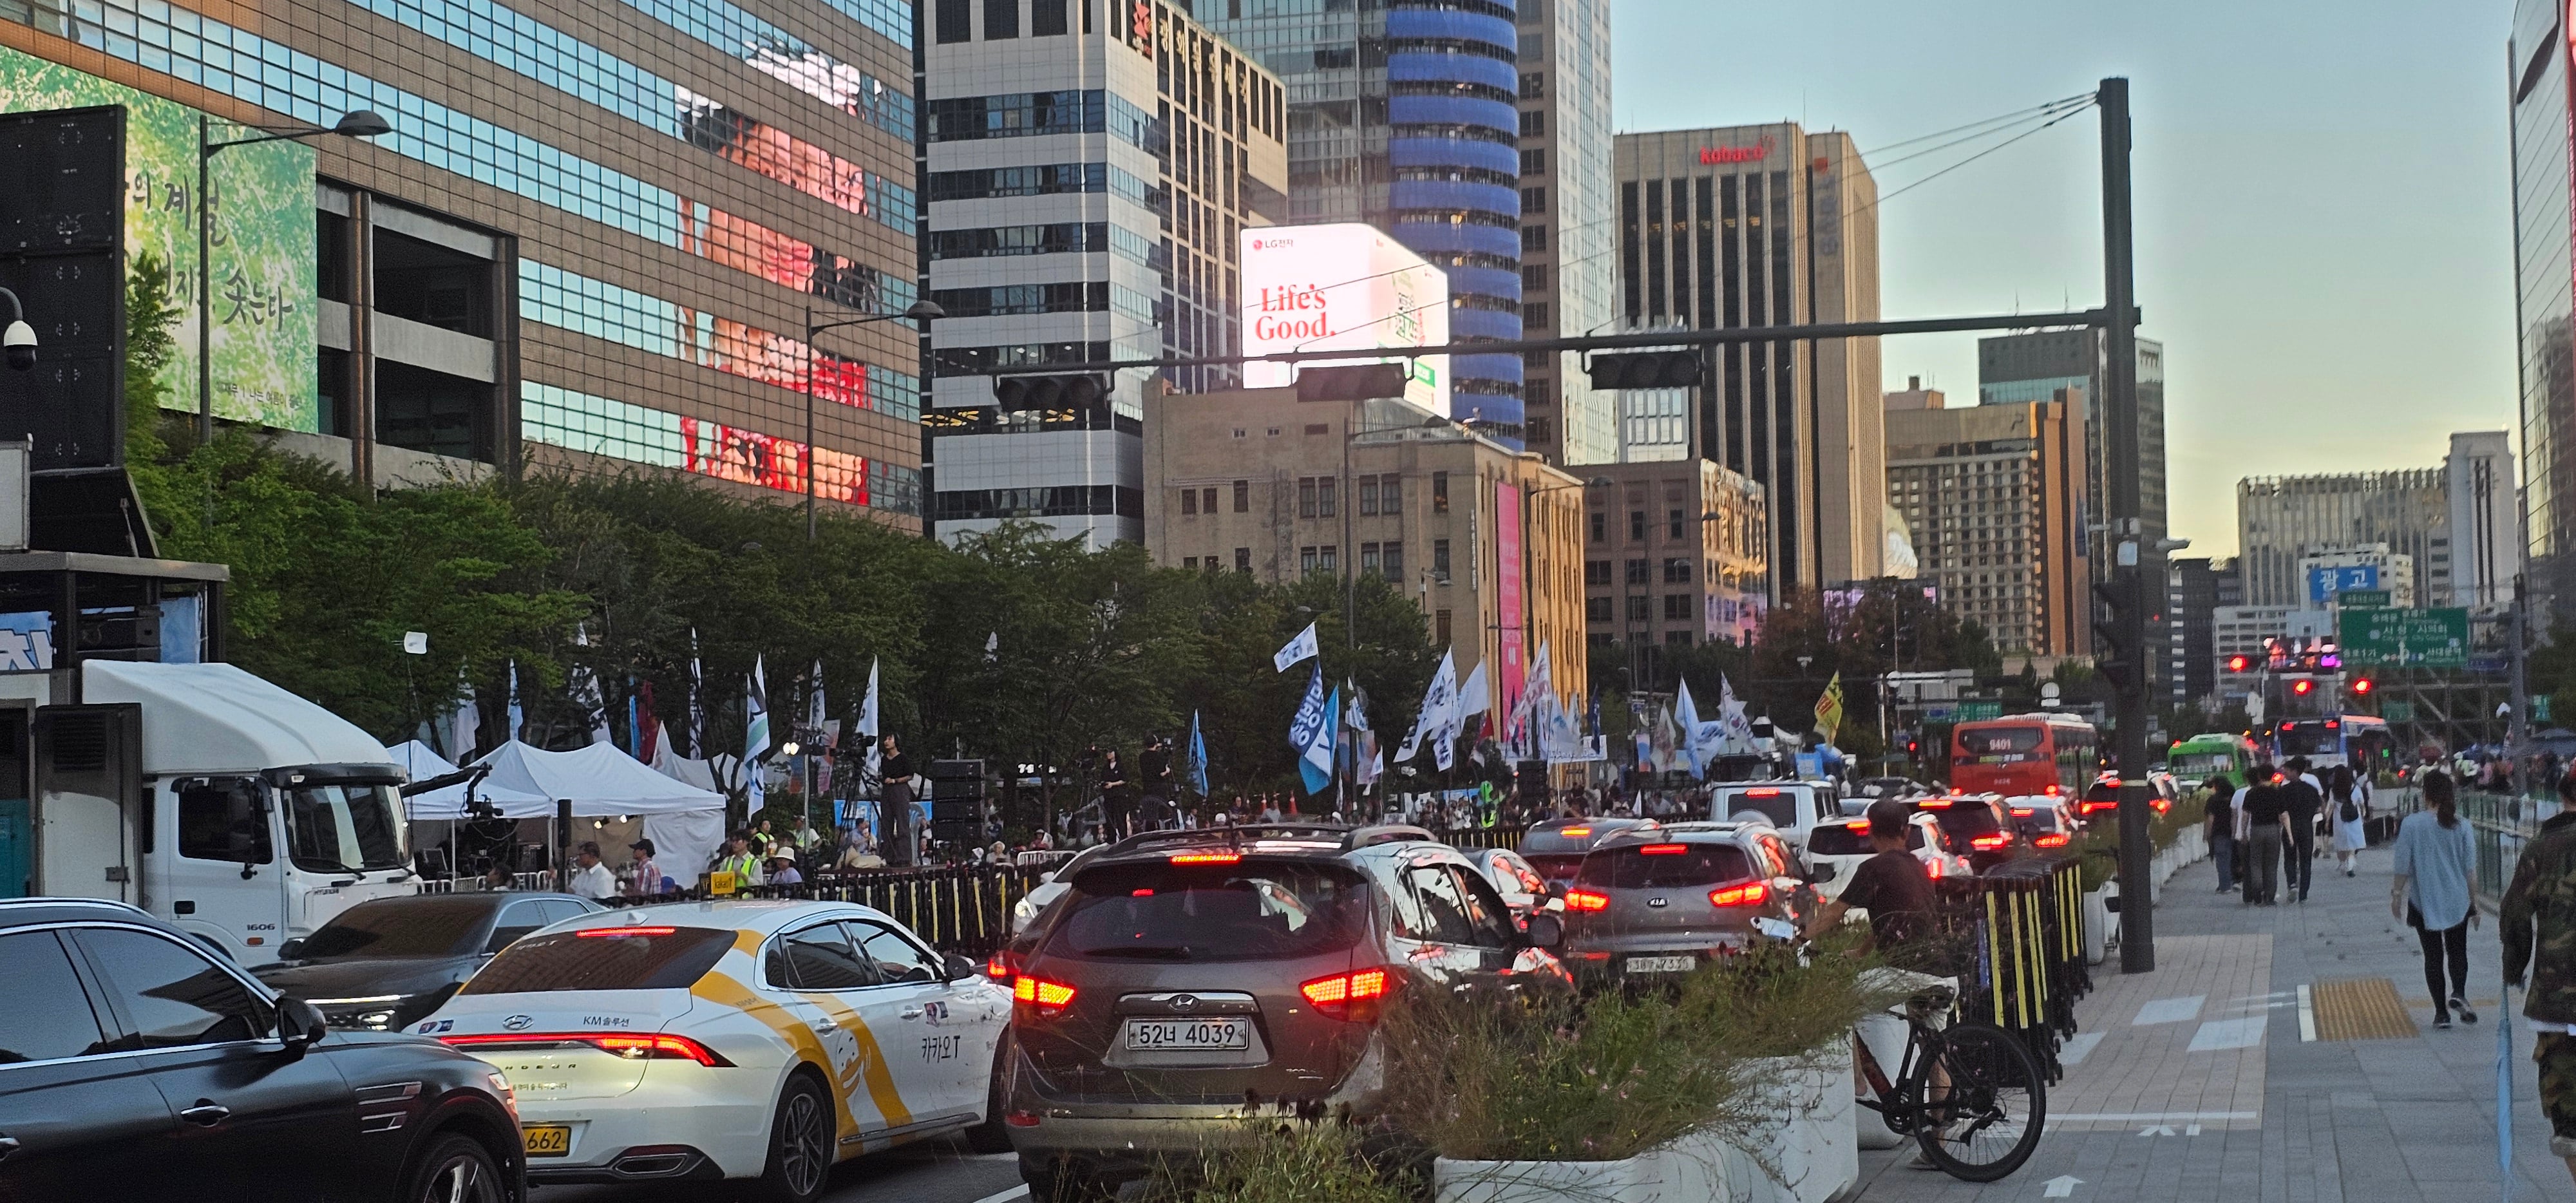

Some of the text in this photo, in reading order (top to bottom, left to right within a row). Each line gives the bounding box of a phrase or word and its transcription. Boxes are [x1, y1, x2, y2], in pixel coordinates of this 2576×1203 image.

[1261, 283, 1327, 312] Life's
[1256, 312, 1336, 341] Good.
[2319, 569, 2369, 592] 광고
[583, 1016, 630, 1027] KM솔루션
[1139, 1024, 1235, 1044] 52너 4039
[527, 1131, 562, 1150] 662
